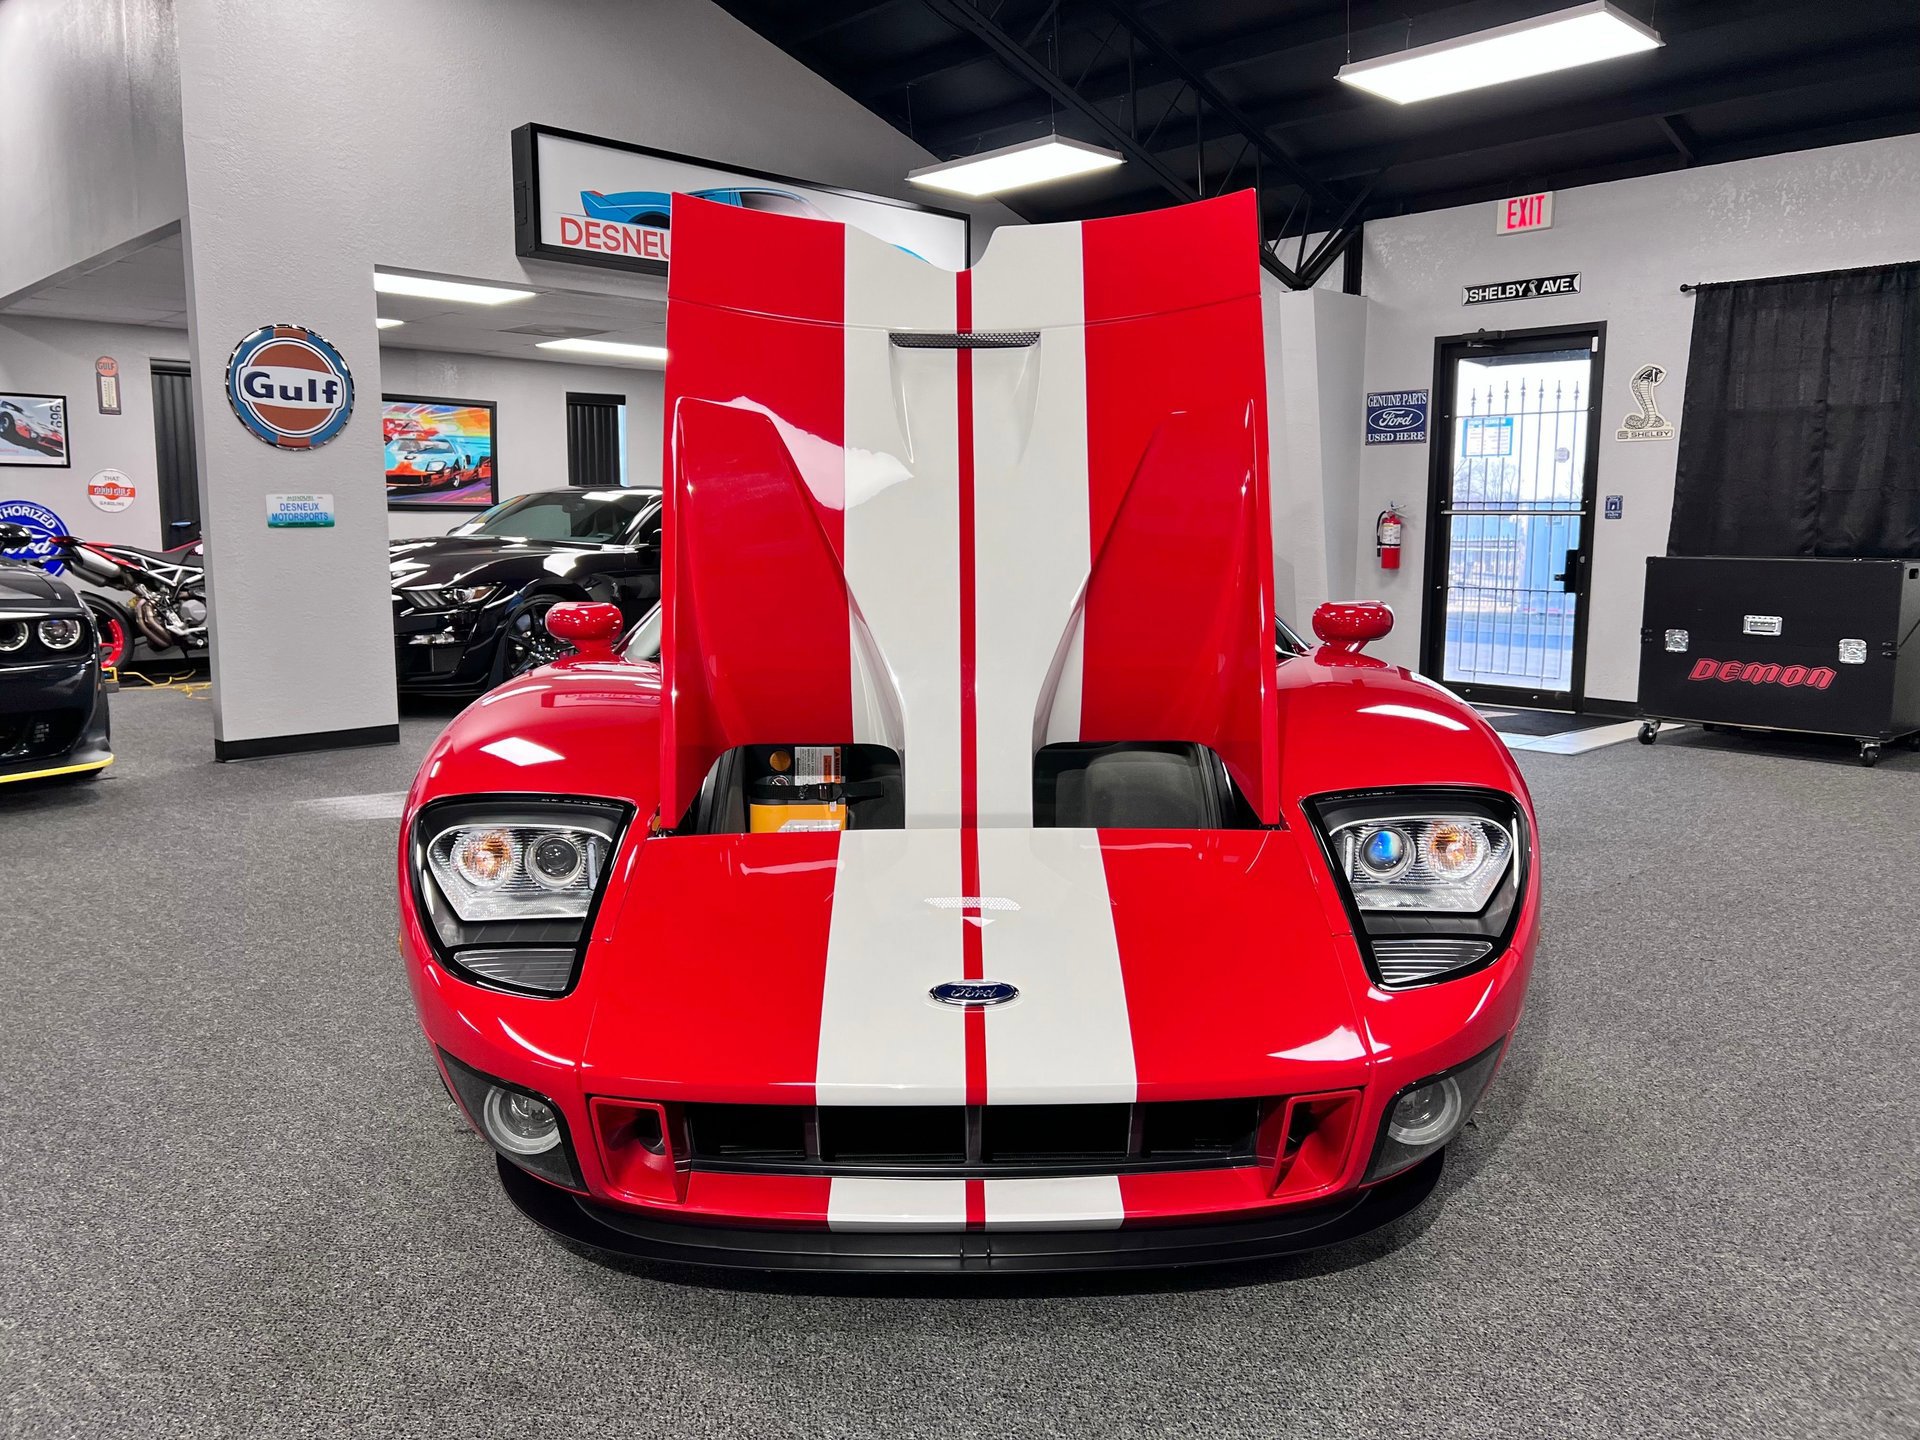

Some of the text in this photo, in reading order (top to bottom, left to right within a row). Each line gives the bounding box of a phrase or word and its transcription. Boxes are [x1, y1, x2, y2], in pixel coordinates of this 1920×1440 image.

[1506, 194, 1545, 229] EXIT
[1469, 278, 1573, 302] SHELBY AVE.
[243, 372, 338, 404] Gulf
[1367, 392, 1427, 408] GENUINE PARTS
[49, 399, 62, 428] 969
[1378, 410, 1413, 427] Ford
[1367, 431, 1425, 442] USED HERE
[279, 502, 320, 512] DESNEUX
[271, 512, 329, 521] MOTORSPORTS
[1688, 658, 1838, 690] DEMON
[950, 986, 998, 998] Ford
